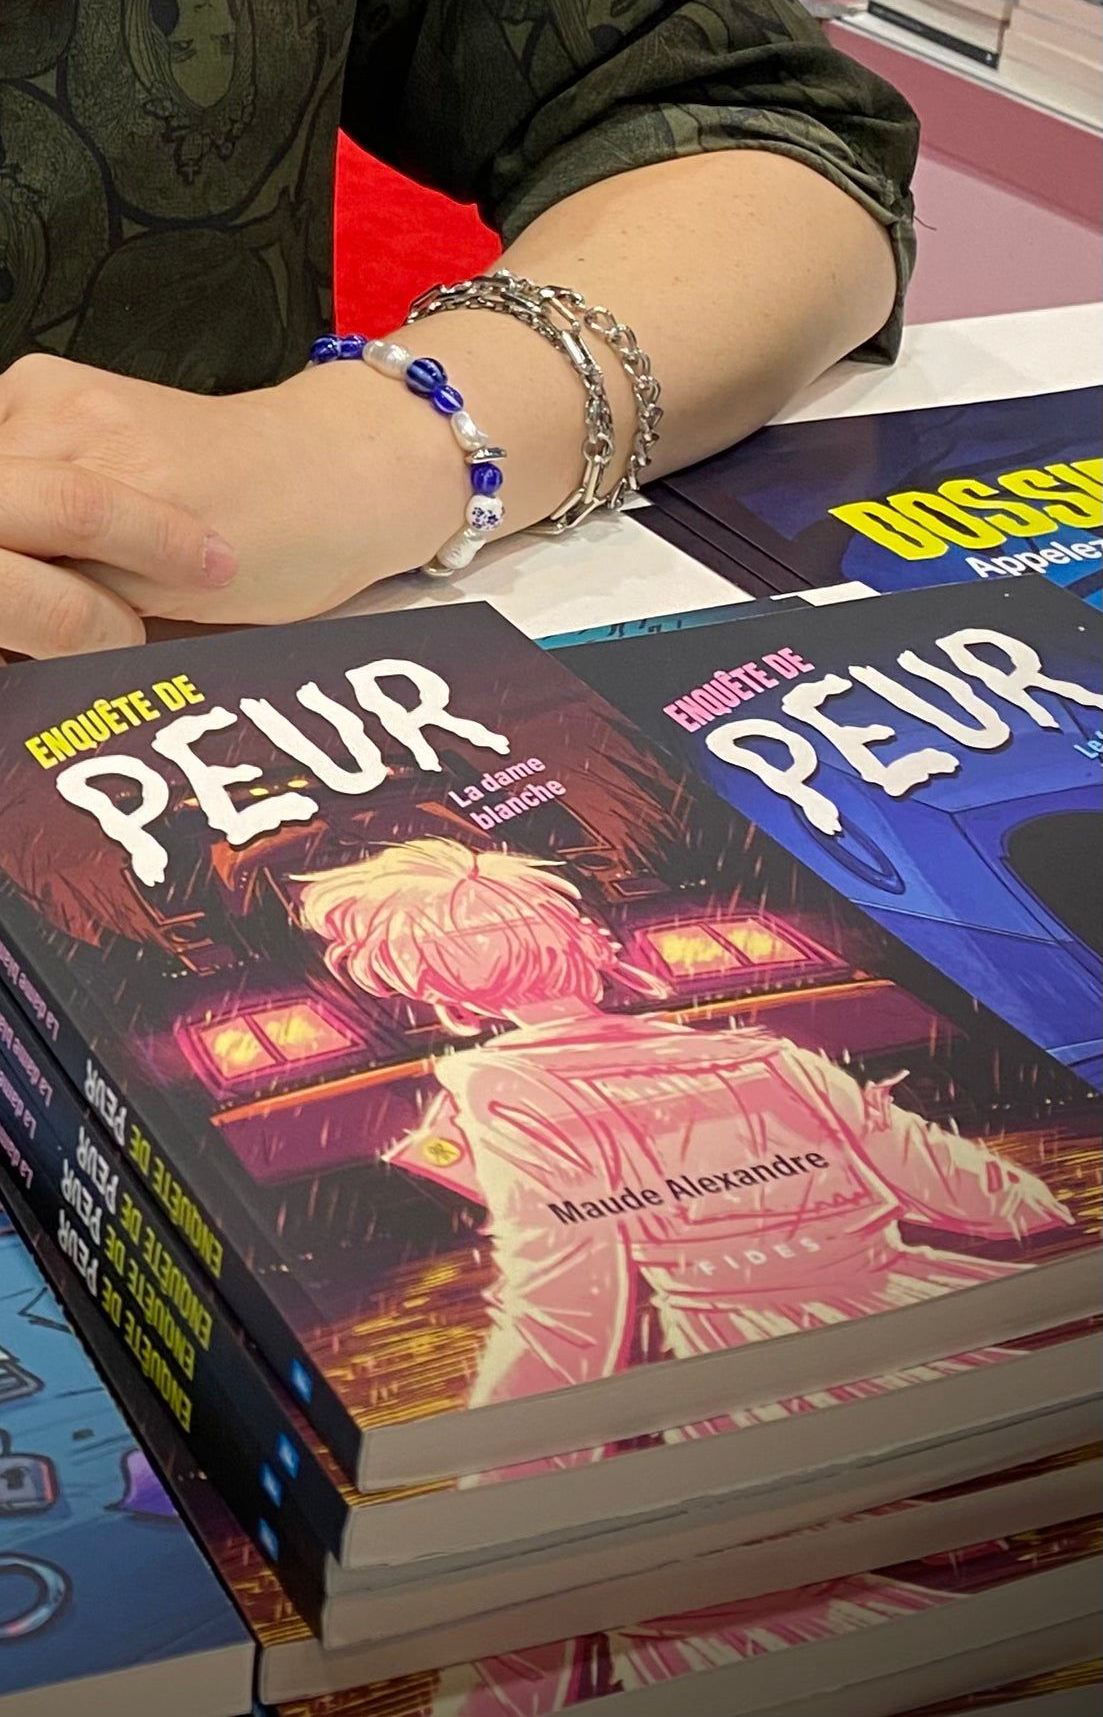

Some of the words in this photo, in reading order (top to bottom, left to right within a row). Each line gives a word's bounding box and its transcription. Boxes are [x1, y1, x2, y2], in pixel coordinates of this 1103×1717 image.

[24, 688, 161, 770] ENQUÊTE
[152, 674, 205, 710] DE
[663, 660, 780, 734] ENQUÊTE
[762, 647, 816, 680] DE
[705, 628, 1103, 836] PEUR
[56, 658, 511, 887] PEUR
[448, 779, 482, 810] La
[478, 754, 547, 799] dame
[469, 777, 567, 833] blanche
[83, 1058, 128, 1147] PEUR
[76, 1125, 120, 1216] PEUR
[129, 1123, 152, 1177] DE
[547, 1188, 665, 1226] Maude
[664, 1148, 830, 1201] Alexandre
[60, 1157, 102, 1247] PEUR
[120, 1192, 143, 1246] DE
[152, 1155, 224, 1281] ENQUÊTE
[57, 1208, 99, 1298] PEUR
[104, 1223, 127, 1276] DE
[143, 1225, 213, 1352] ENQUÊTE
[698, 1237, 822, 1277] FIDES
[101, 1275, 123, 1329] DE
[127, 1258, 195, 1382] ENQUÊTE
[123, 1309, 193, 1434] ENQUÊTE
